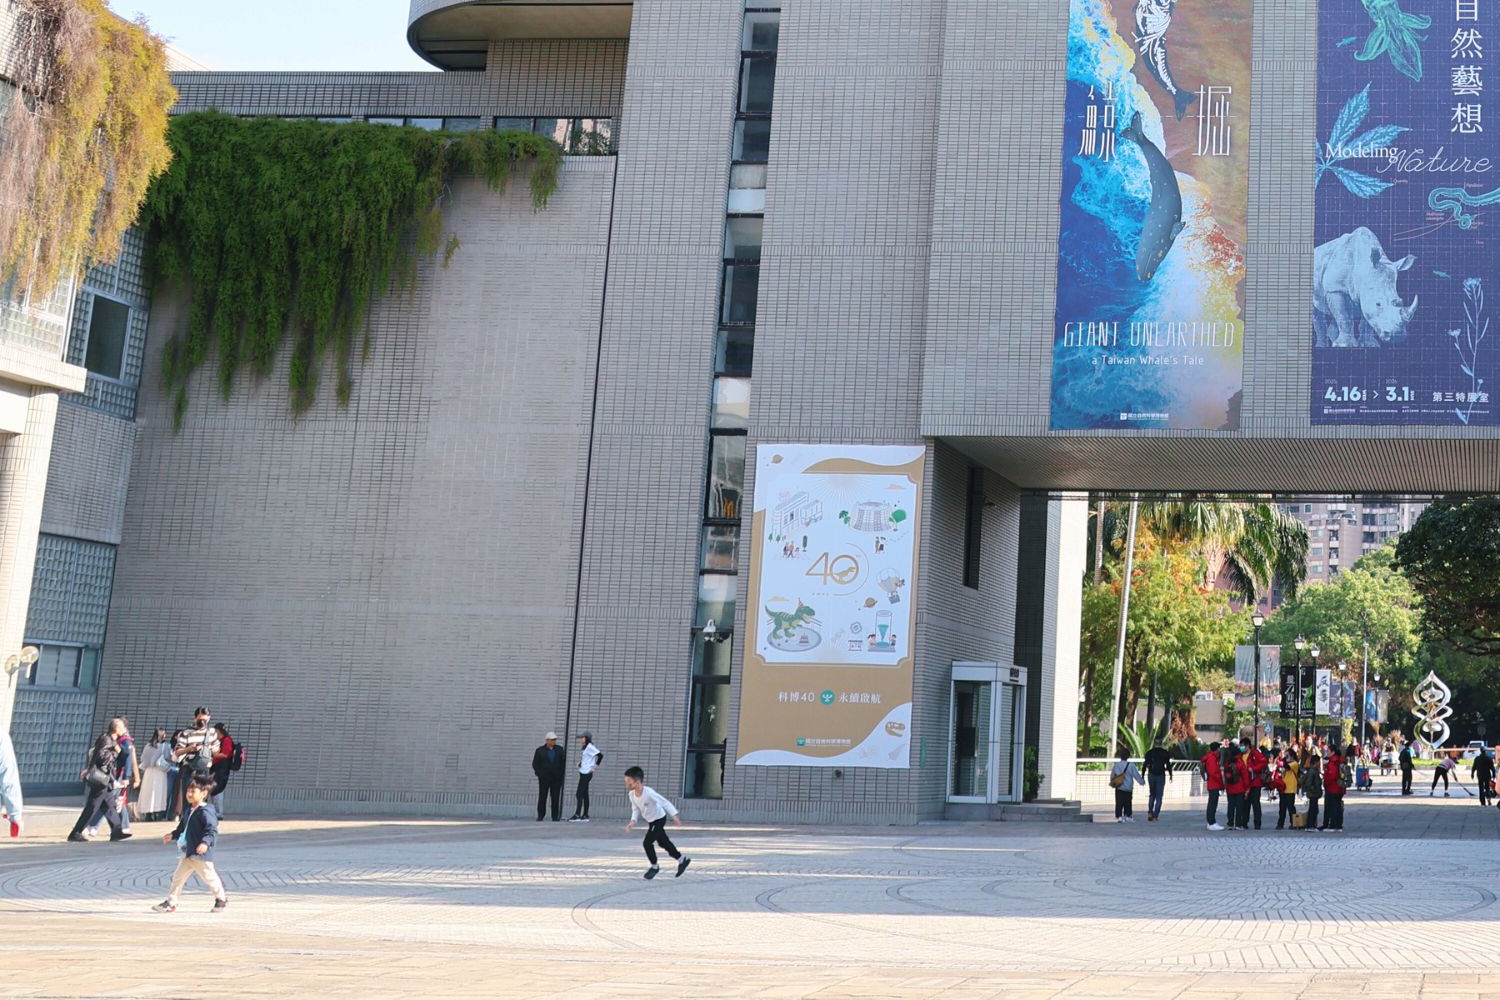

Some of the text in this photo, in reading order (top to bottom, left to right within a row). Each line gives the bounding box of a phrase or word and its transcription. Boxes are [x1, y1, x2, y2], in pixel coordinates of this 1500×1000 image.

[1325, 142, 1399, 164] Modeling
[1376, 146, 1493, 174] Nature
[1063, 321, 1235, 348] GIANT UNEARTHED
[1091, 355, 1205, 365] a Taiwan Whale's Tale
[1324, 386, 1361, 402] 4.16
[1385, 386, 1410, 402] 3.1
[1432, 391, 1489, 403] 第三特展室
[805, 551, 860, 586] 40
